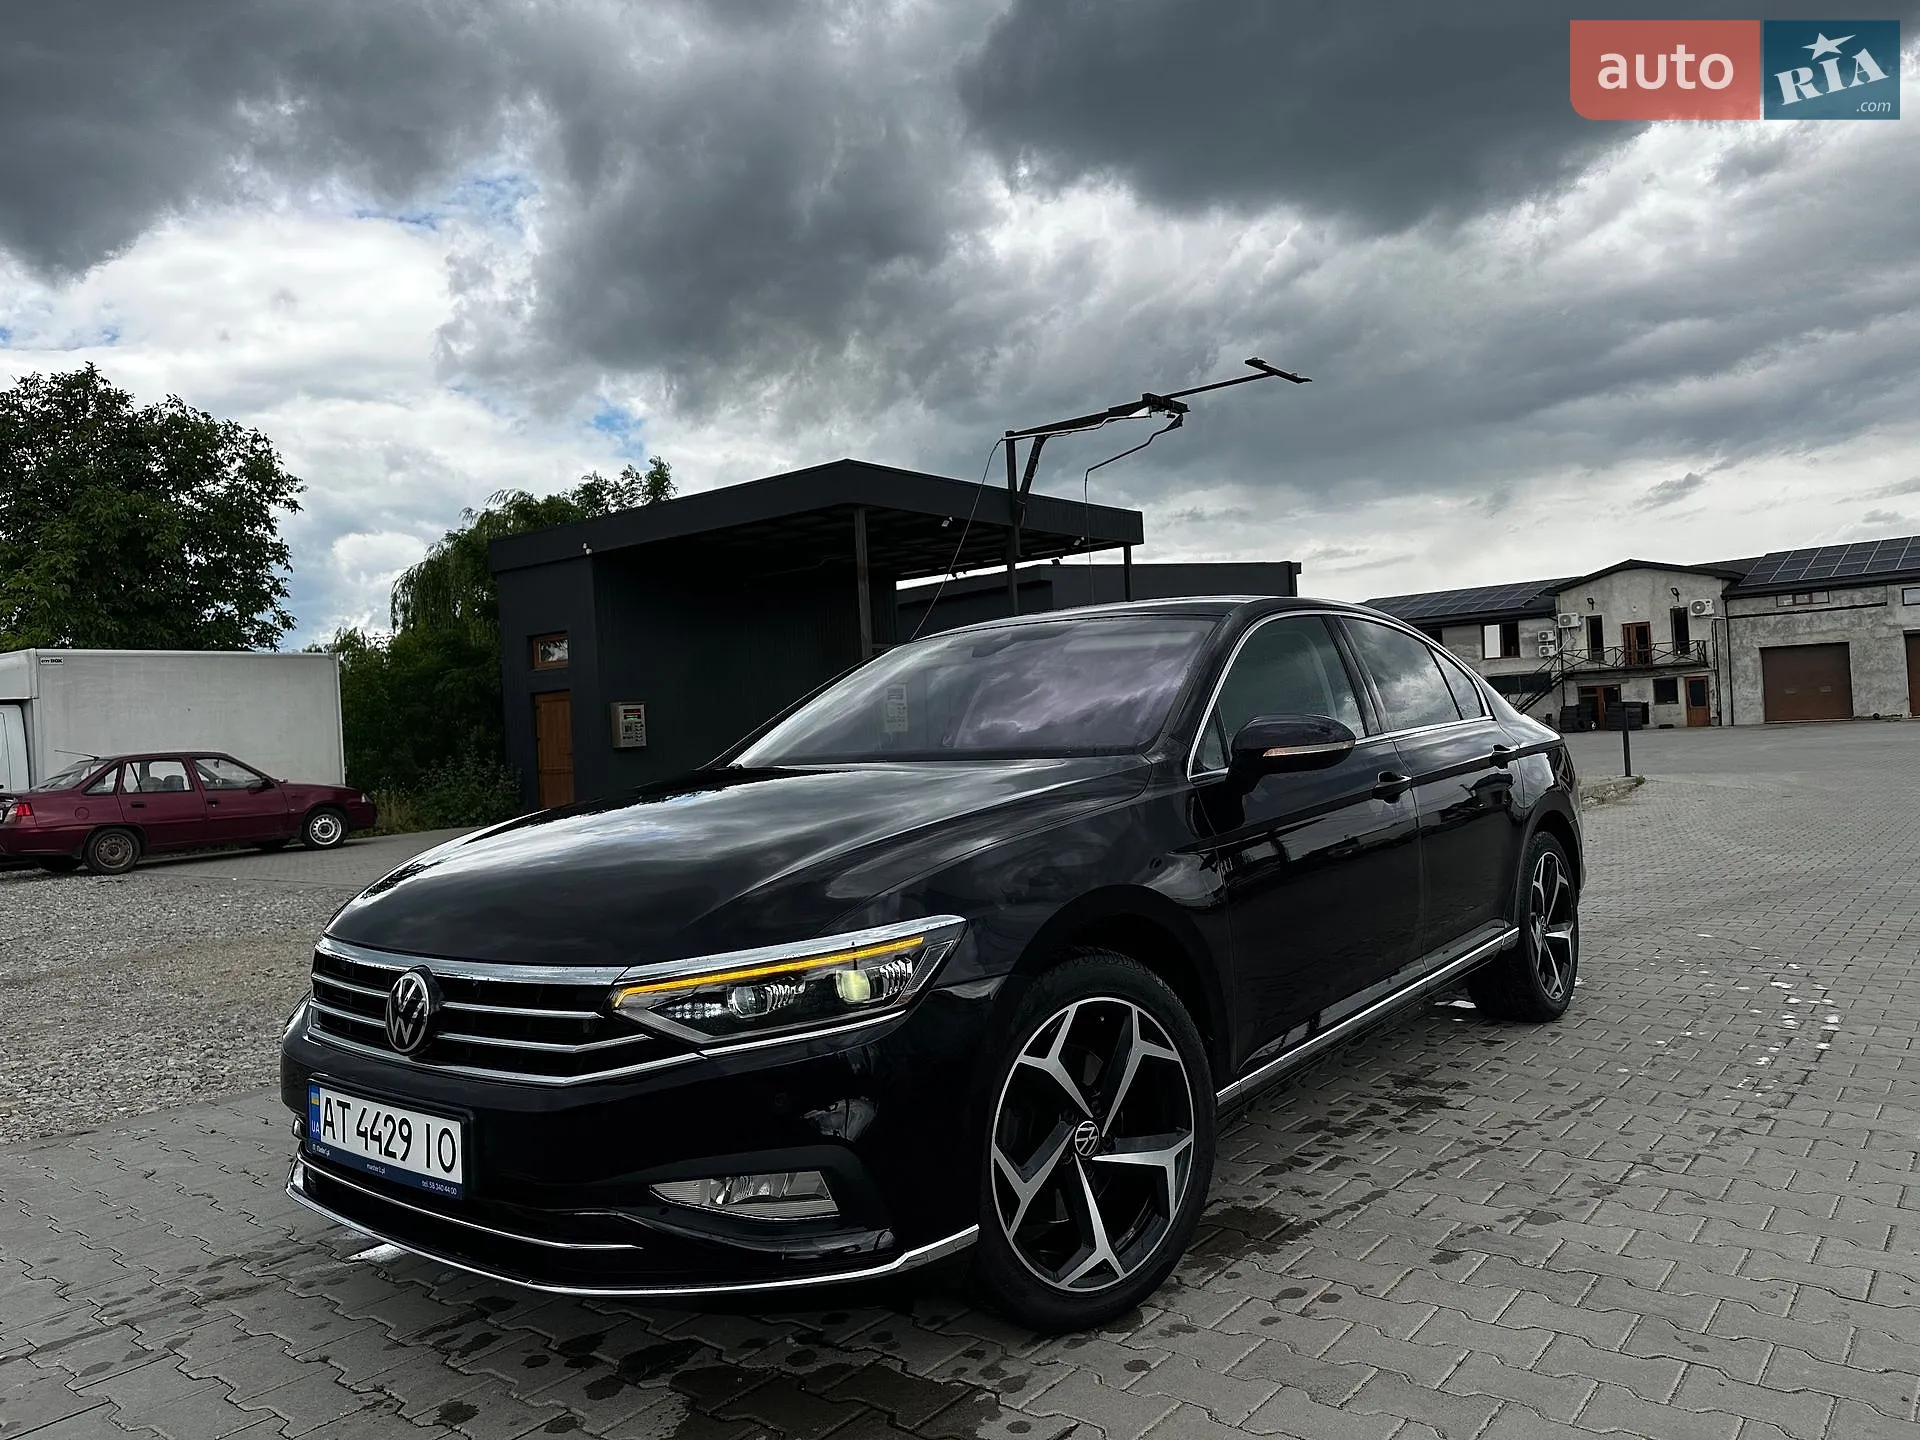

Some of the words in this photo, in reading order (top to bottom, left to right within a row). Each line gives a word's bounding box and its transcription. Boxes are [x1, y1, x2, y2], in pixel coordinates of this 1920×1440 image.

[312, 1120, 320, 1133] UA
[322, 1096, 352, 1144] AT
[356, 1107, 412, 1161] 4429
[425, 1123, 457, 1174] IO
